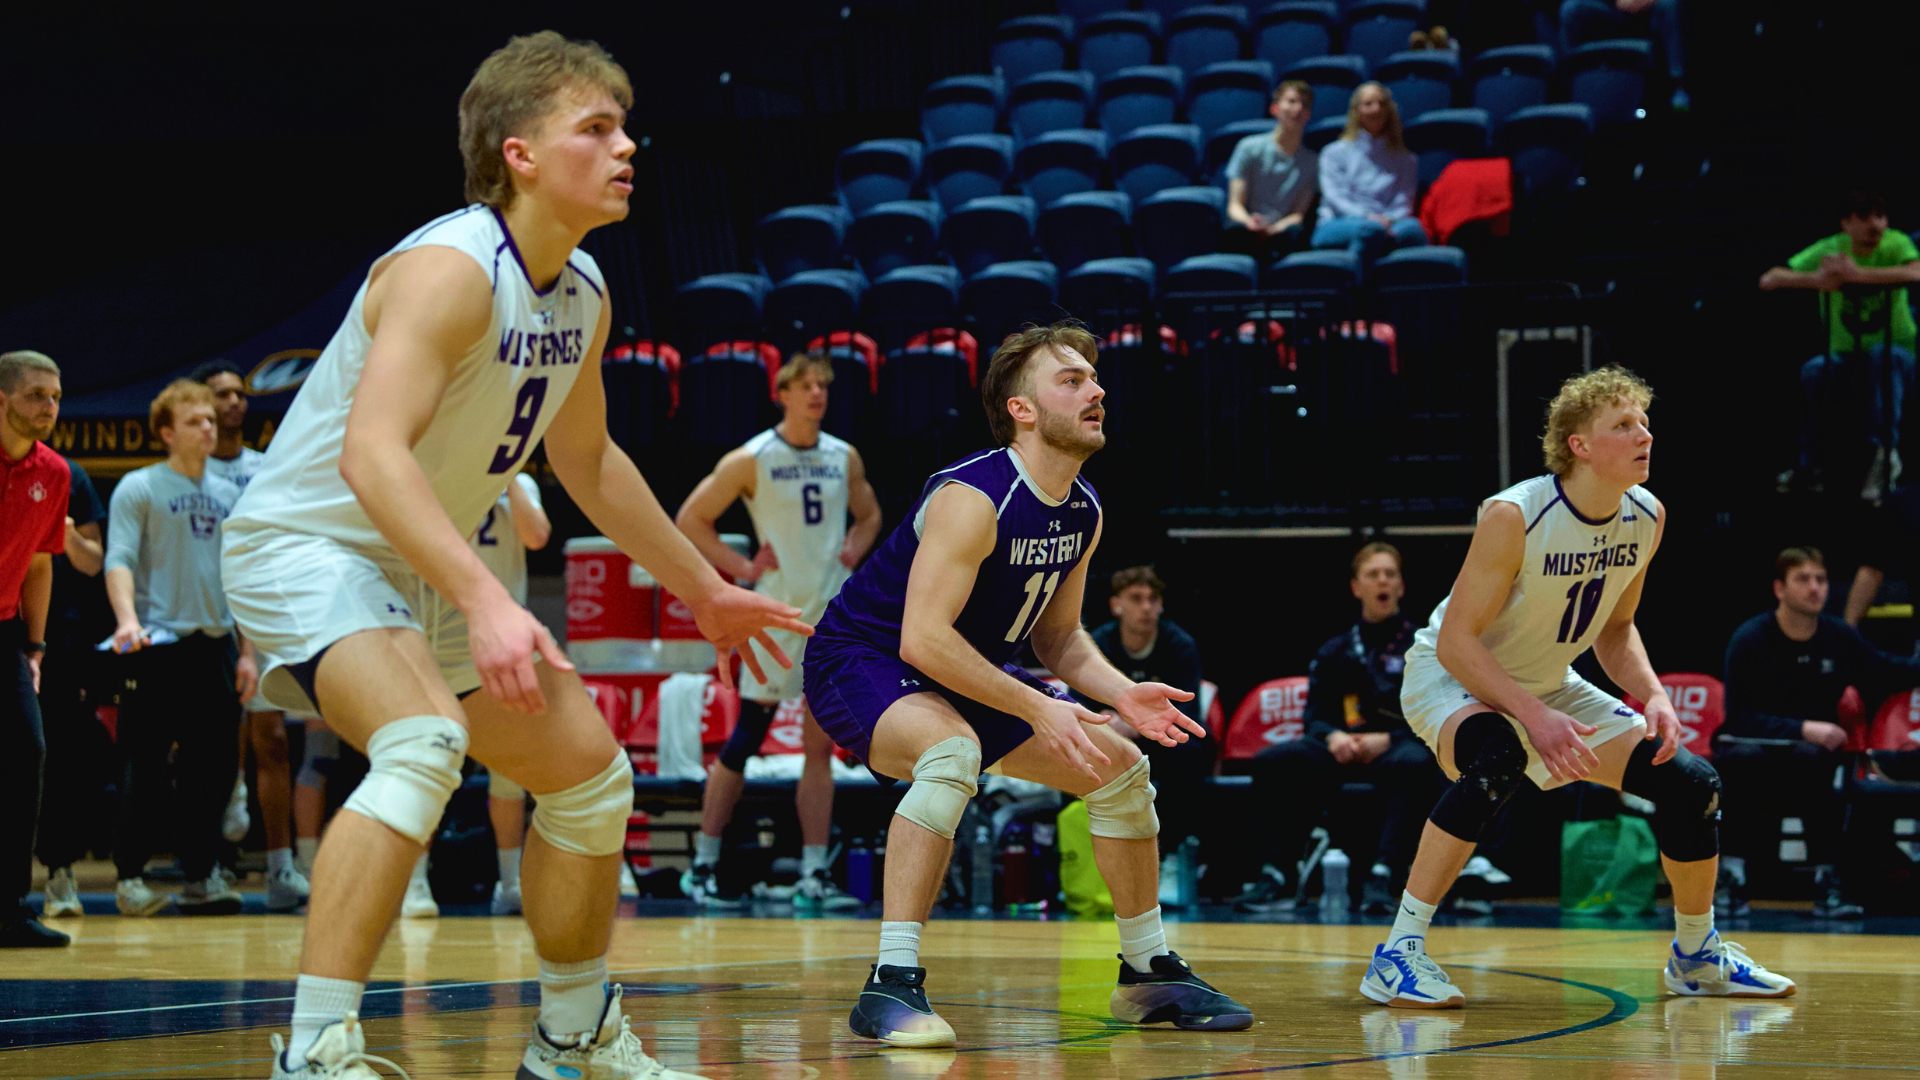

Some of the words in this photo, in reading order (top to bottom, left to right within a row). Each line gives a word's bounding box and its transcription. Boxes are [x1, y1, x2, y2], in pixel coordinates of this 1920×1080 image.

[488, 377, 549, 475] 9
[803, 484, 823, 525] 6
[1009, 531, 1083, 566] WESTERN
[1004, 570, 1061, 643] 11
[1556, 573, 1607, 643] 10
